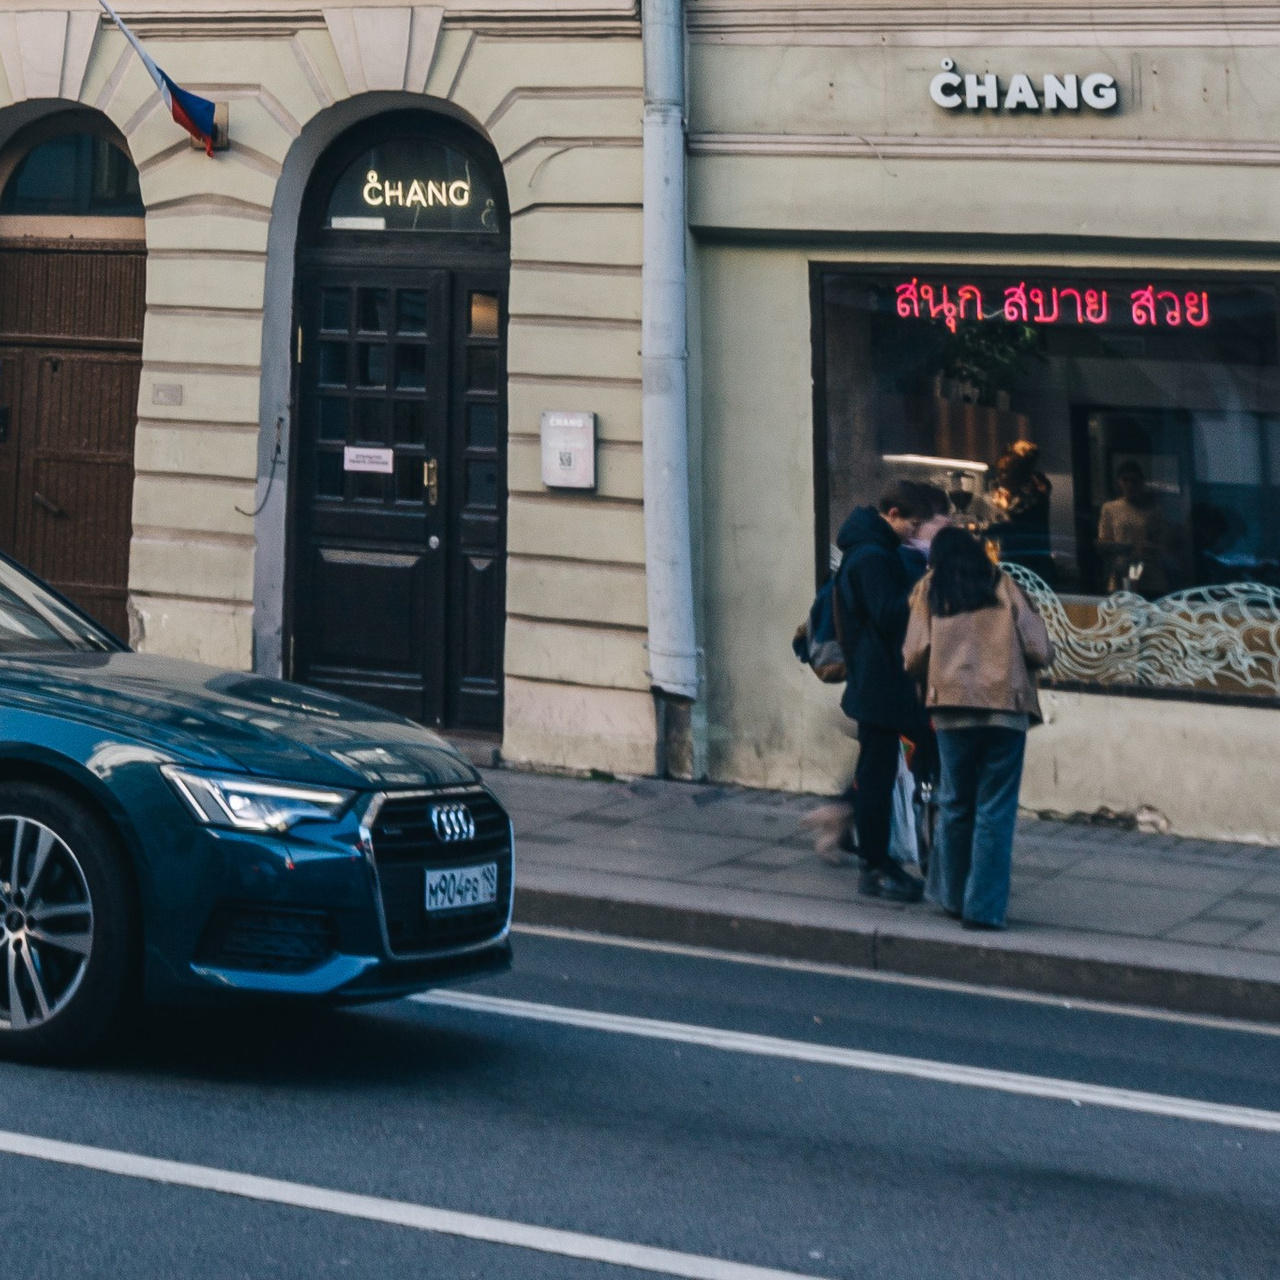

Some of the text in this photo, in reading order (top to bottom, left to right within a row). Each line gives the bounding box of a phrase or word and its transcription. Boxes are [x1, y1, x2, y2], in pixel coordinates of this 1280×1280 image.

[895, 278, 1210, 333] สนุก สบาย สวย
